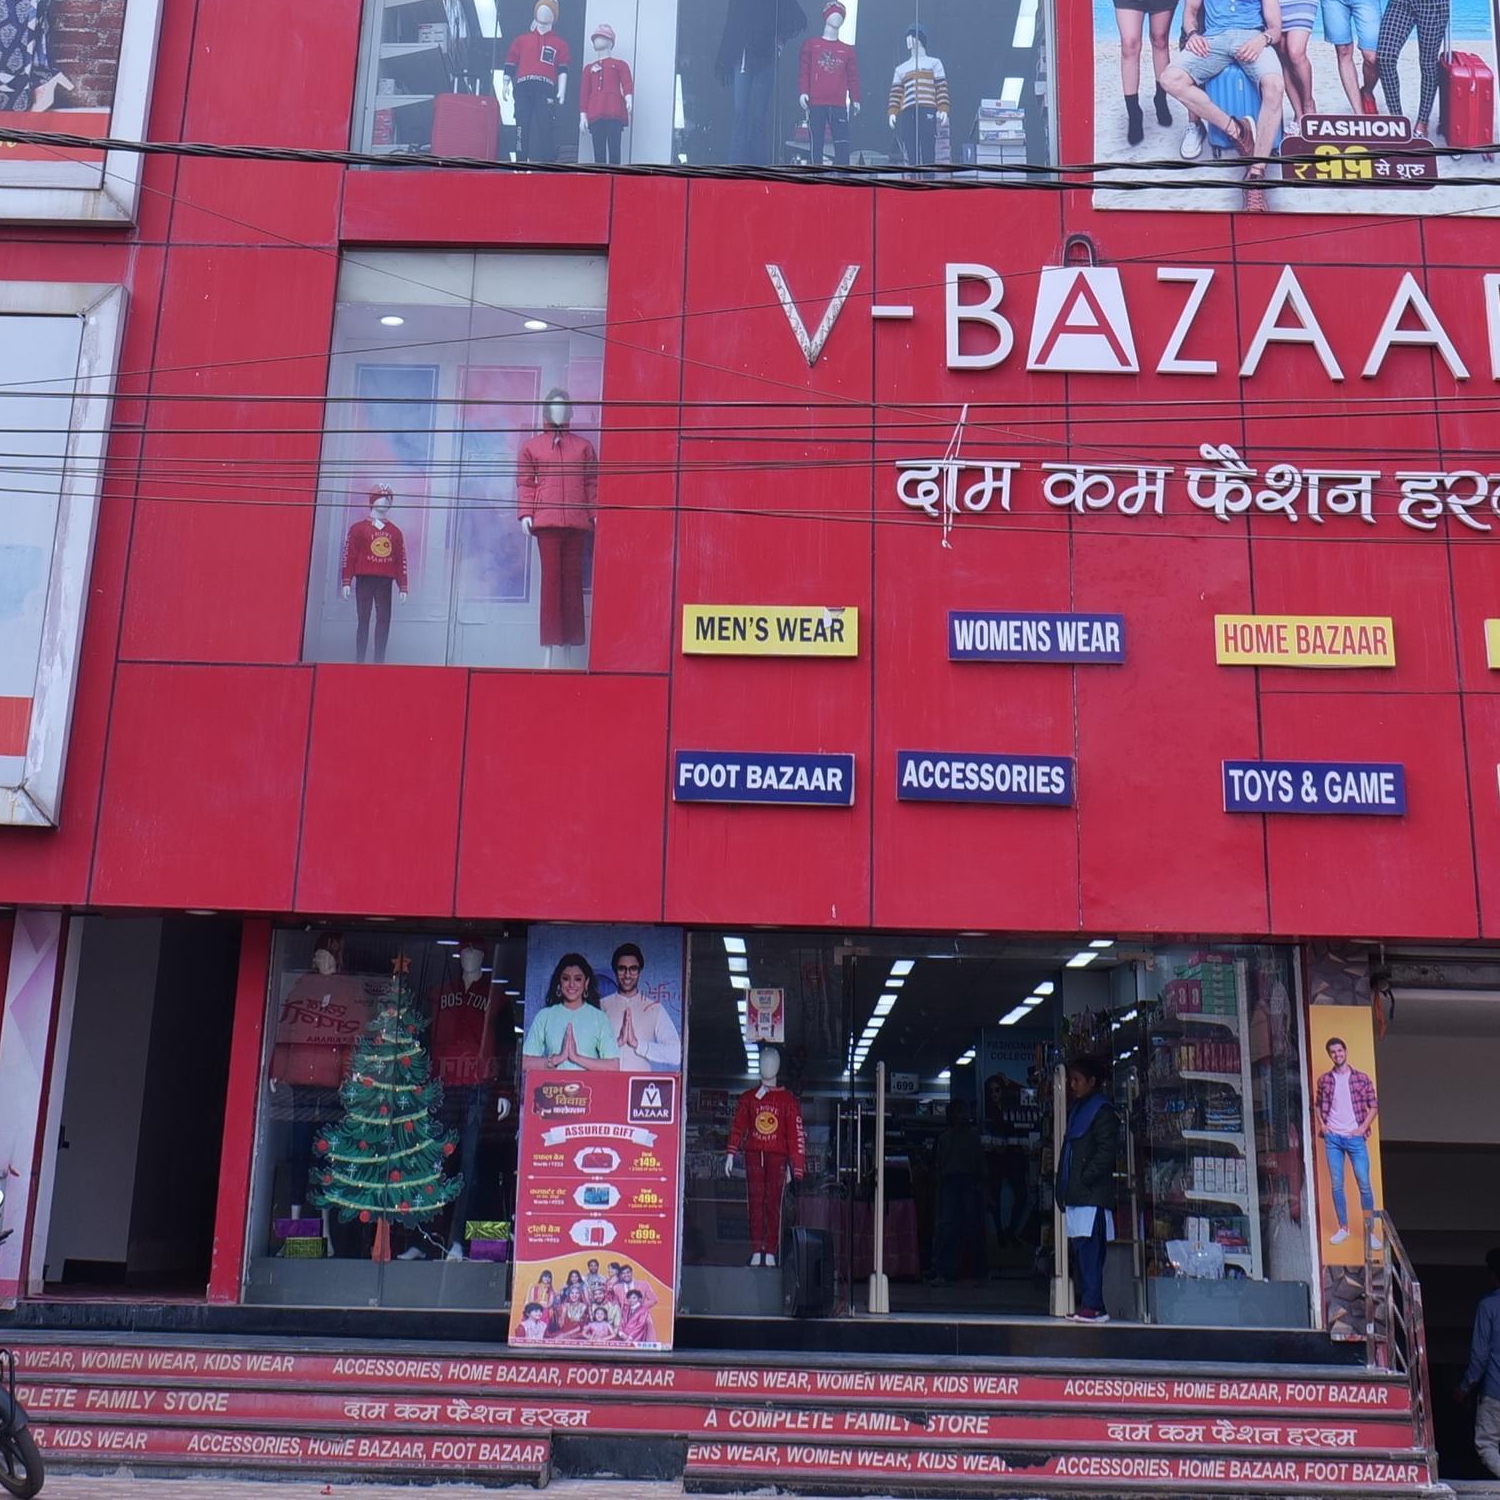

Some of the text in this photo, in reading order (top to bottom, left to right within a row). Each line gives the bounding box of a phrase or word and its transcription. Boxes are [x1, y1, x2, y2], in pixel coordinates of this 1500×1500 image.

[1306, 120, 1406, 138] FASHION
[1374, 159, 1390, 176] से
[895, 460, 1020, 517] दाम
[1041, 462, 1173, 516] कम
[1186, 444, 1381, 525] फैशन
[695, 615, 844, 643] MEN'S WEAR
[954, 619, 1121, 653] WOMENS WEAR
[1223, 623, 1388, 655] HOME BAZAAR
[679, 763, 842, 792] FOOT BAZAAR
[902, 759, 1065, 794] ACCESSORIES
[1229, 769, 1396, 804] TOYS & GAME
[440, 993, 491, 1012] BOSTON
[633, 1109, 669, 1118] BAZAAR
[565, 1124, 635, 1138] ASSURED GIFT
[24, 1351, 76, 1372] WEAR,
[81, 1352, 142, 1370] WOMEN
[148, 1353, 198, 1373] WEAR,
[204, 1354, 241, 1371] KIDS
[246, 1355, 294, 1373] WEAR
[332, 1357, 675, 1387] ACCESSORIES, HOME BAZAAR, FOOT BAZAAR
[715, 1370, 1019, 1395] MENS WEAR, WOMEN WEAR, KIDS WEAR
[1064, 1379, 1388, 1404] ACCESSORIES, HOME BAZAAR, FOOT BAZAAR
[15, 1387, 230, 1412] PLETE FAMILY STORE
[344, 1398, 591, 1428] दाम कम फैशन हरदम
[703, 1409, 990, 1434] A COMPLETE FAMILY STORE
[53, 1429, 92, 1448] KIDS
[97, 1431, 147, 1449] WEAR
[1107, 1419, 1357, 1447] दाम कम फैशन हरदम
[187, 1434, 545, 1463] ACCESSORIES, HOME BAZAAR, FOOT BAZAAR
[687, 1444, 721, 1460] ENS
[726, 1445, 781, 1465] WEAR,
[787, 1447, 851, 1465] WOMEN
[857, 1450, 912, 1469] WEAR,
[917, 1452, 957, 1470] KIDS
[1056, 1456, 1419, 1483] ACCESSORIES, HOME BAZAAR, FOOT BAZAAR
